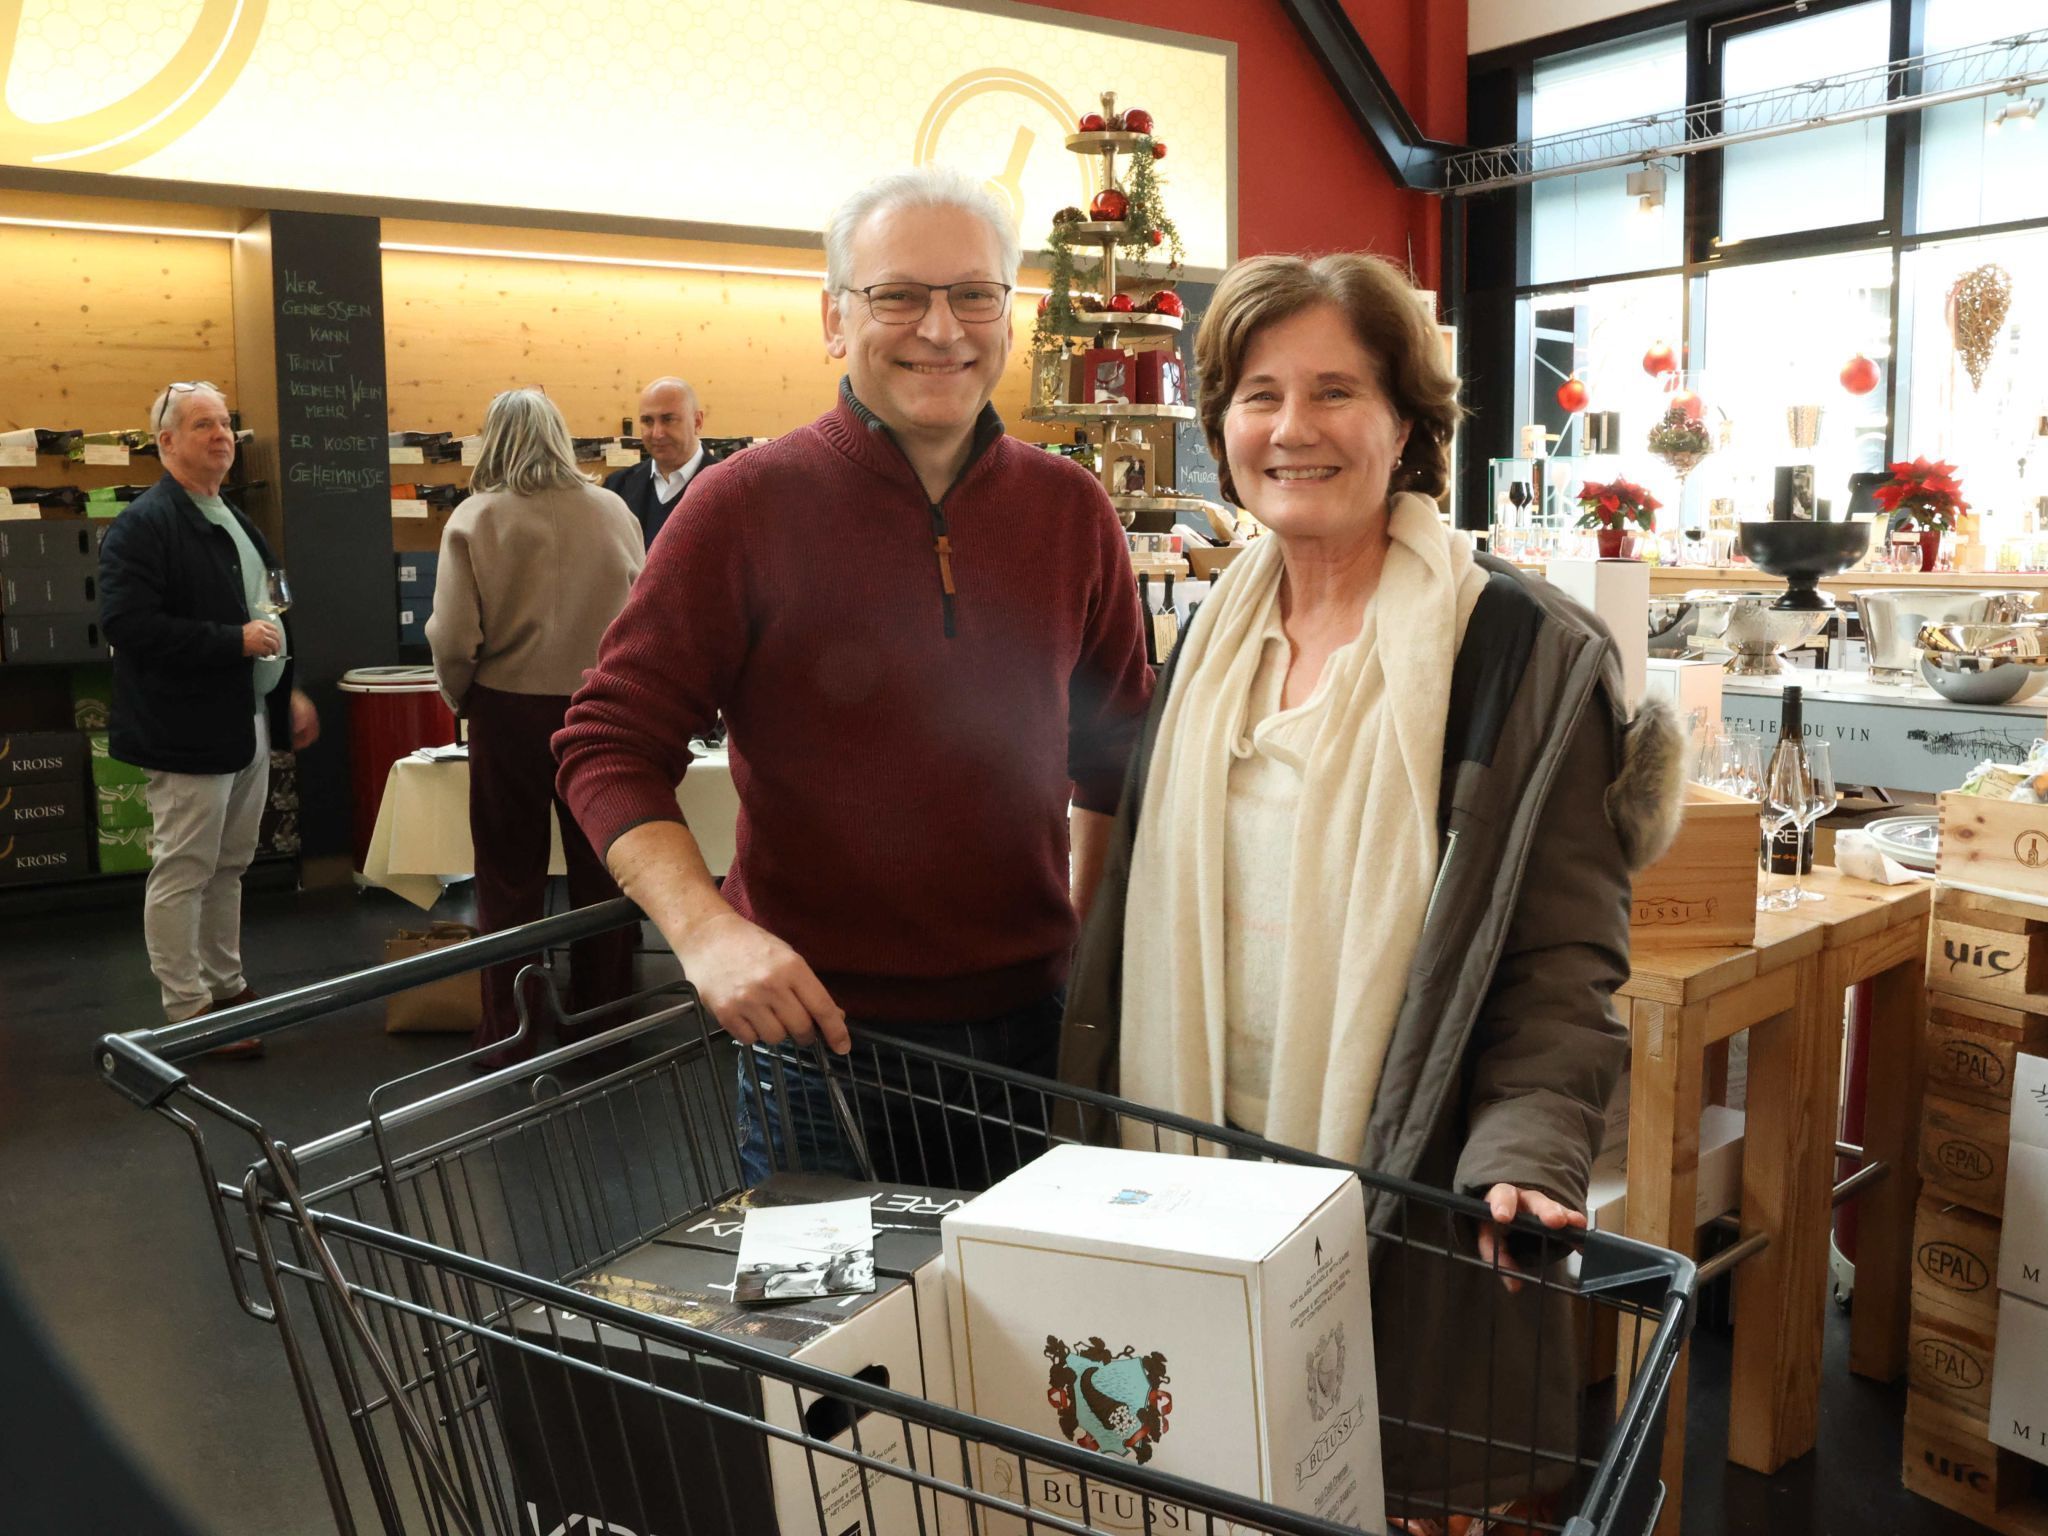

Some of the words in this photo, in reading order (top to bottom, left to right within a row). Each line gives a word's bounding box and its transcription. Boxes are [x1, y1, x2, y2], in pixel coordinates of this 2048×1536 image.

[1724, 716, 1778, 734] TELIE
[1803, 723, 1825, 738] DU
[1836, 726, 1871, 742] VIN
[12, 756, 64, 772] KROISS
[14, 804, 66, 821] KROISS
[16, 852, 68, 869] KROISS
[1640, 906, 1690, 920] USSI
[1927, 1248, 1978, 1287] EPAL
[1310, 1414, 1352, 1471] BUTUSSI
[823, 1496, 844, 1515] ONTIENE
[1043, 1478, 1193, 1532] BUTUSSI
